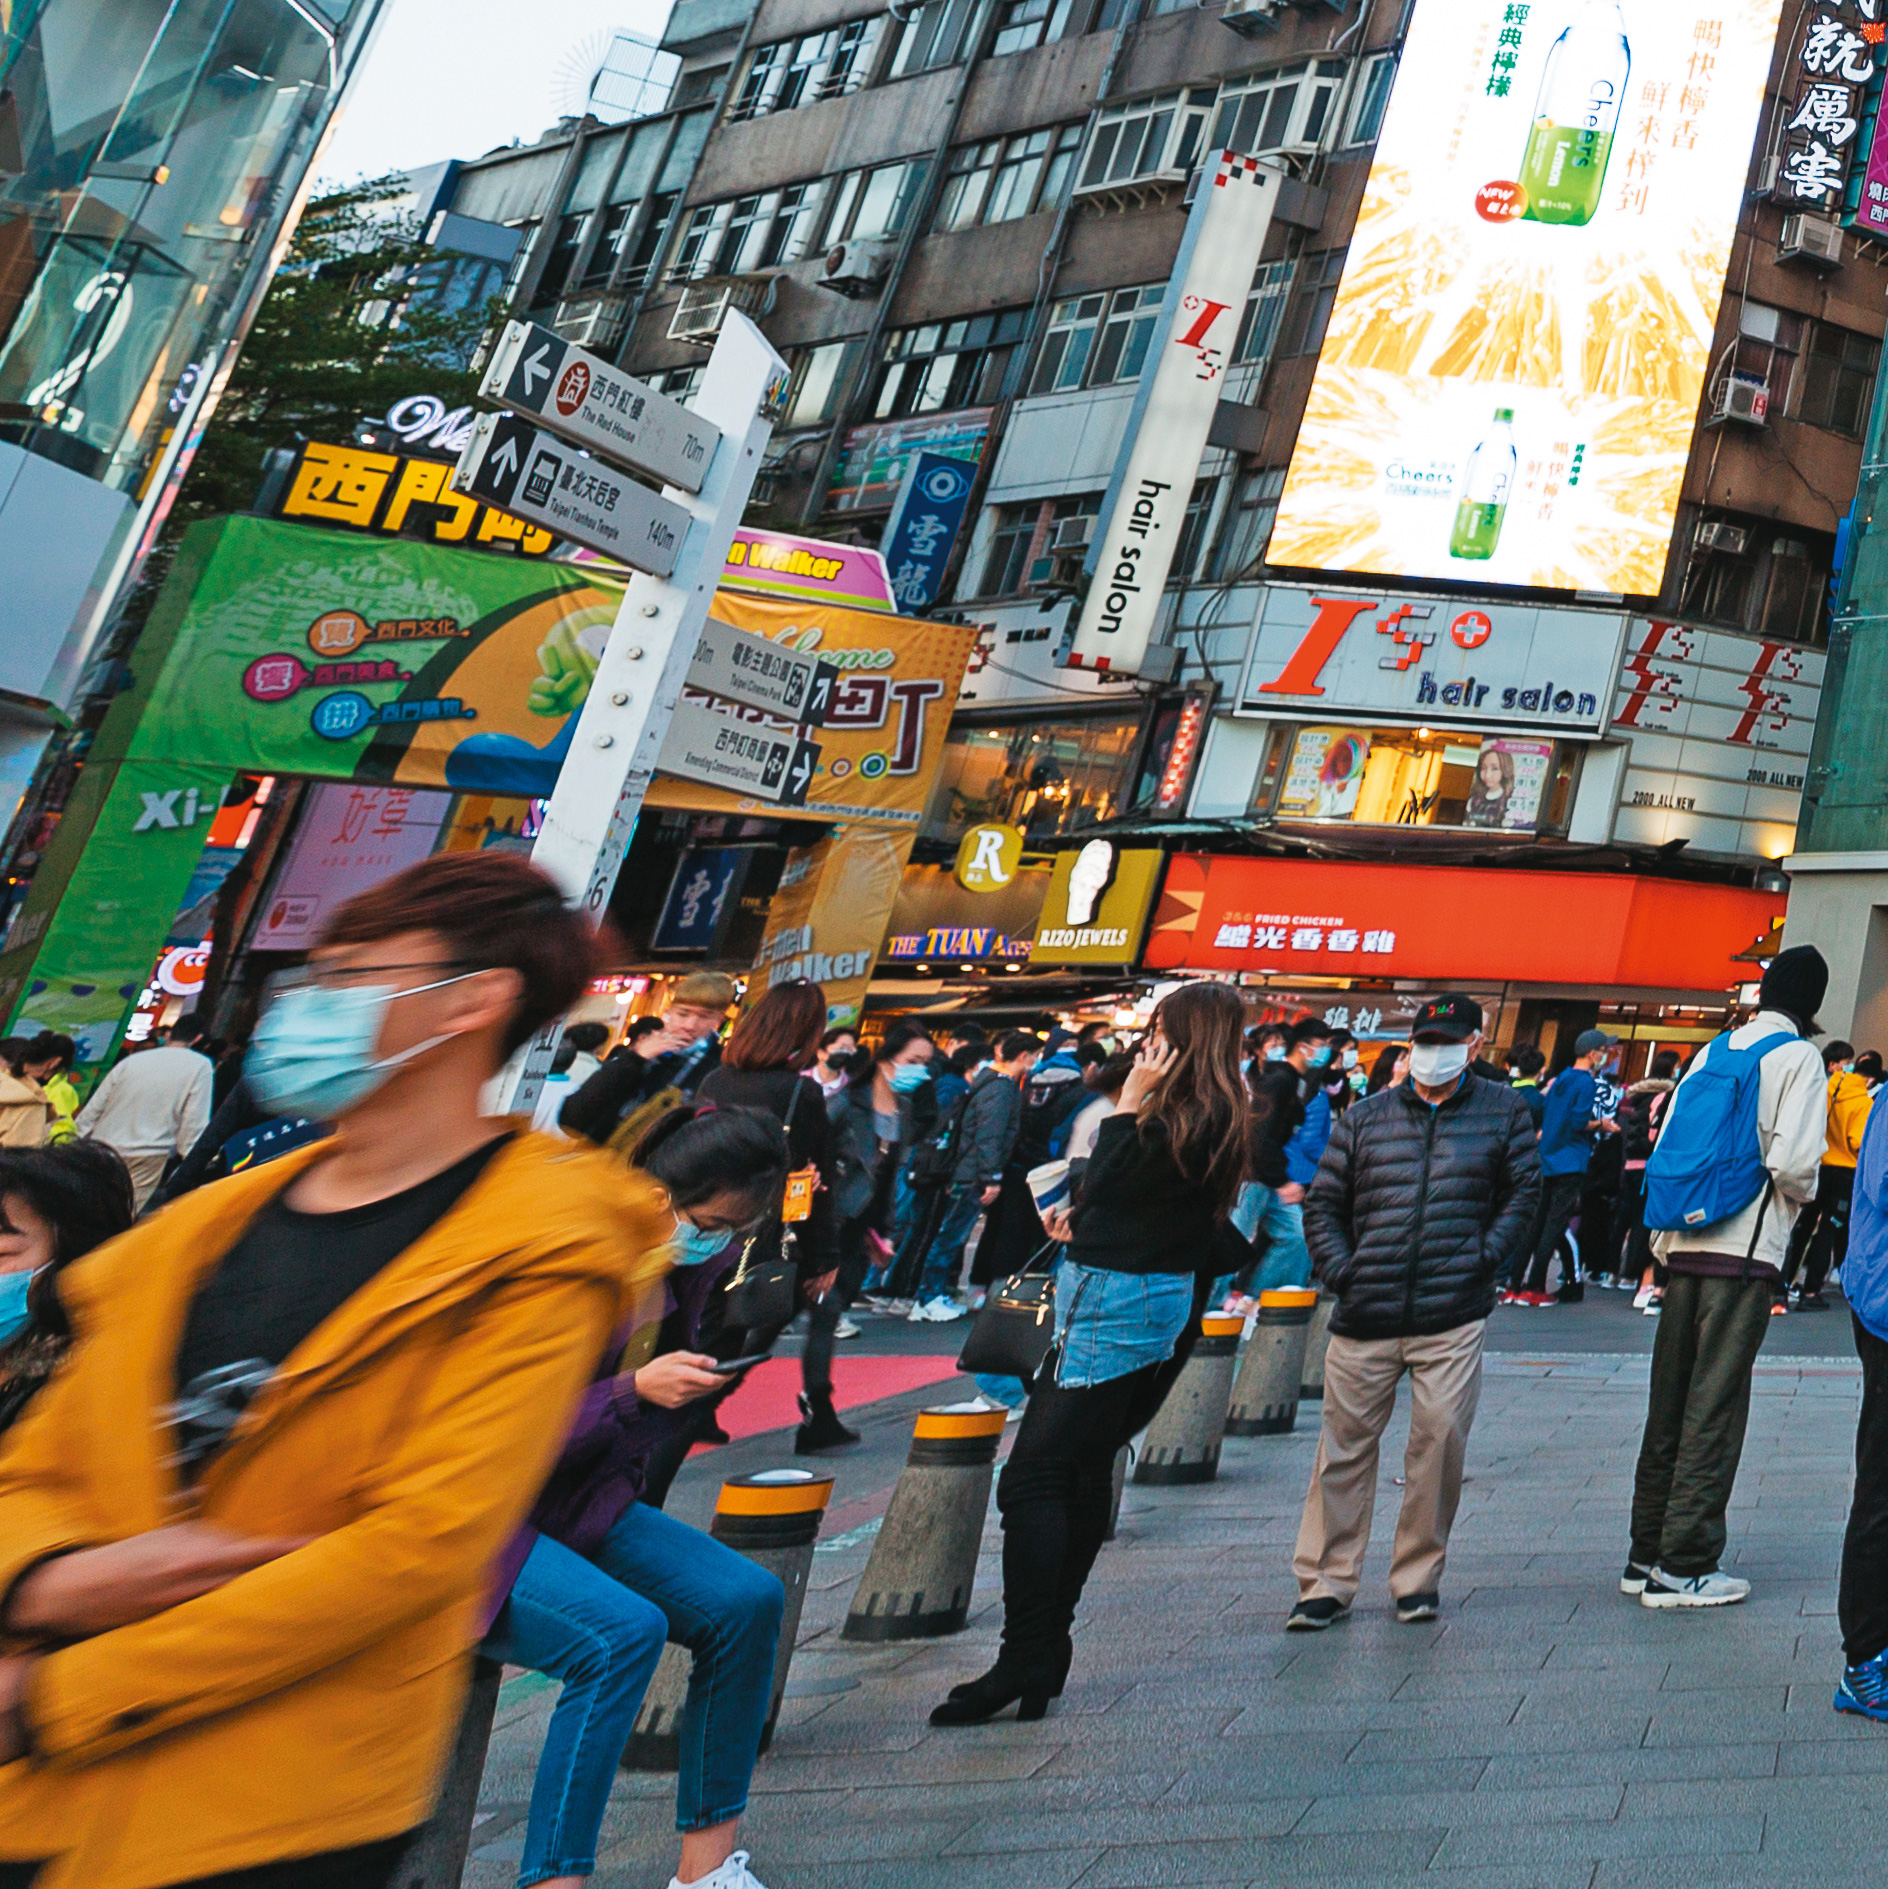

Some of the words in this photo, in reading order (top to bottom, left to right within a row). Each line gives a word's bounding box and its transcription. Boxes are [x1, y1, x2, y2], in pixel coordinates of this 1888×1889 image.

[1572, 79, 1614, 167] Cheers
[1548, 140, 1571, 187] Lemon
[589, 374, 646, 422] 西門紅樓
[581, 405, 597, 423] The
[613, 419, 636, 444] House
[681, 433, 705, 463] 70m
[558, 465, 622, 513] 臺北天后宮
[1385, 463, 1453, 484] Cheers
[550, 497, 570, 519] Taipei
[1125, 479, 1171, 541] hair
[649, 519, 675, 550] 140m
[749, 542, 843, 581] Walker
[1098, 545, 1141, 635] salon
[1417, 673, 1489, 706] hair
[1502, 682, 1596, 714] salon
[1747, 770, 1766, 783] 2000
[1770, 772, 1783, 785] ALL
[1633, 791, 1654, 804] 2000
[1659, 794, 1674, 807] ALL
[1677, 797, 1695, 810] NEW
[969, 830, 1009, 882] R
[1039, 929, 1072, 947] RIZO
[1072, 929, 1128, 948] JEWELS
[1255, 914, 1290, 924] FRIED
[1292, 915, 1343, 926] CHICKEN
[889, 936, 919, 956] THE
[926, 929, 991, 956] TUAN
